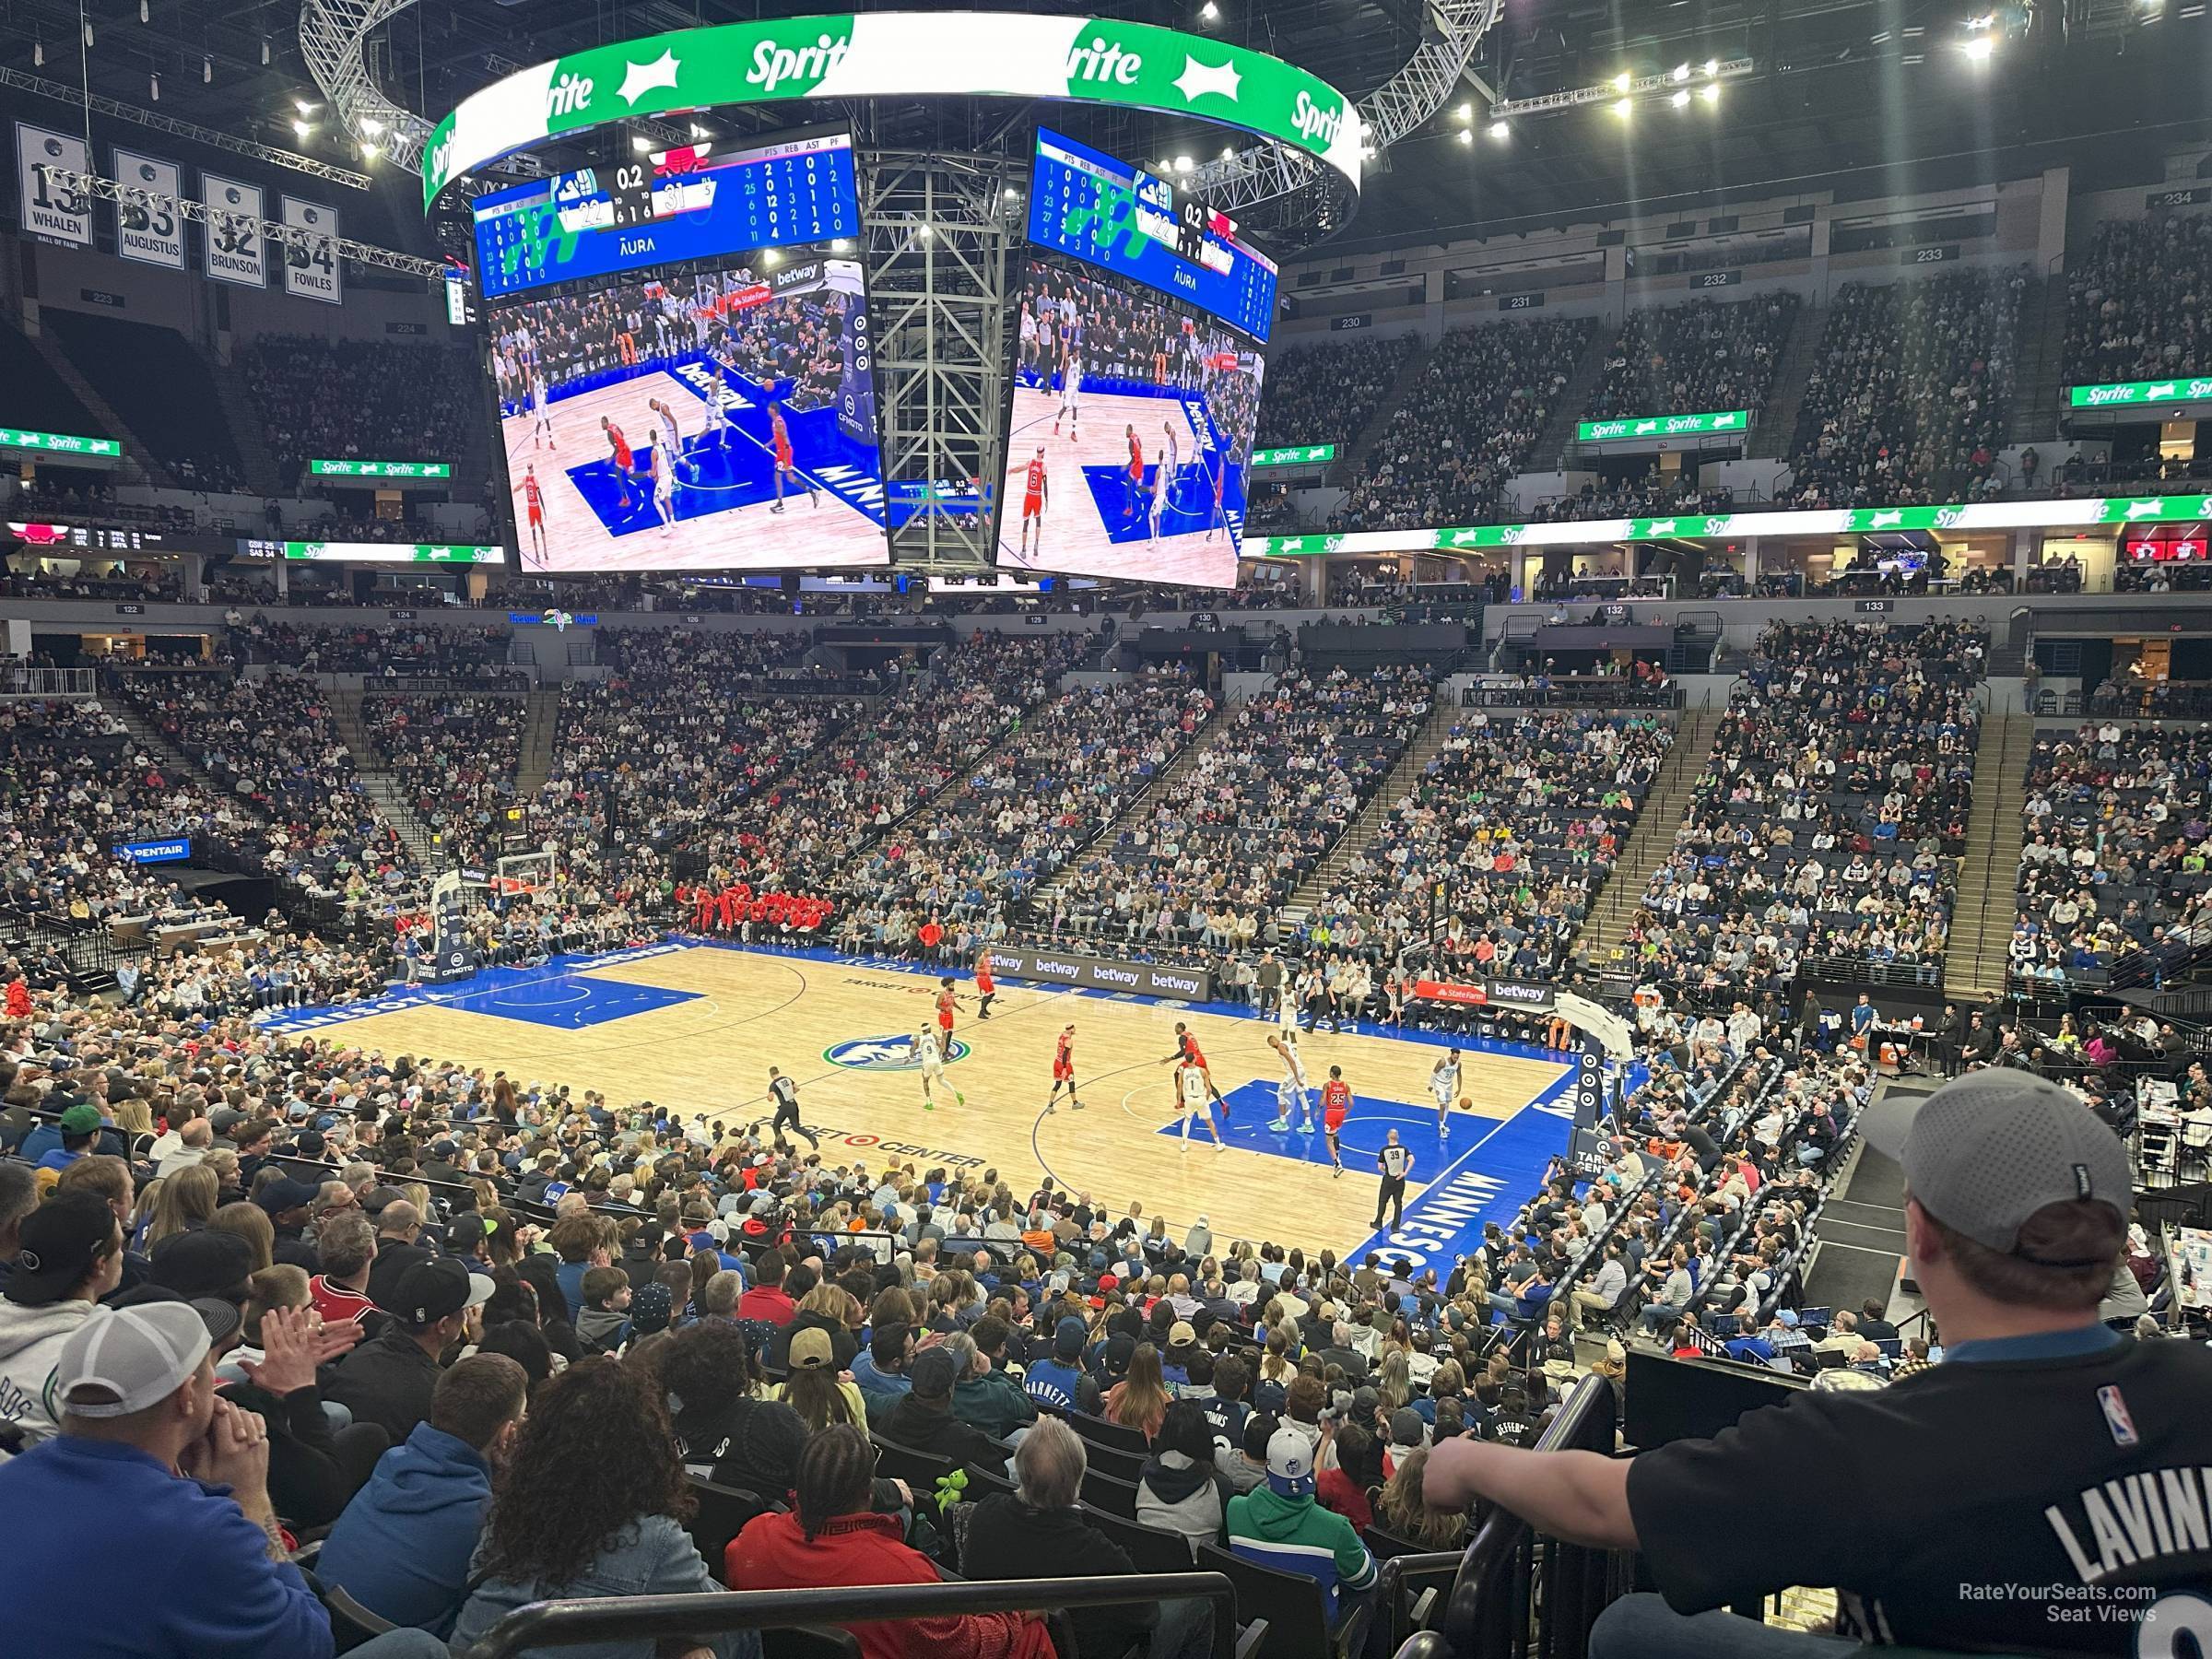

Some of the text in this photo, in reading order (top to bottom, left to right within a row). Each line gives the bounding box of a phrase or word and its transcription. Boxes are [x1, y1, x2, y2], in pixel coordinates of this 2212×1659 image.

[765, 147, 778, 157] PTS
[785, 144, 798, 153] REB
[806, 141, 820, 149] AST
[746, 154, 833, 178] 3 2 2 0 1
[1065, 154, 1106, 176] PTS REB AST
[617, 164, 643, 190] 0.2
[745, 171, 837, 194] 25 0 1 0 2
[1050, 164, 1115, 200] 1 0 0 0 0
[665, 182, 686, 210] 31
[705, 185, 711, 195] 5
[748, 186, 837, 210] 6 12 3 1 1
[1048, 180, 1114, 216] 9 0 0 0 0
[2164, 192, 2192, 205] 234
[579, 199, 603, 227] 22
[1044, 195, 1068, 214] 23 4
[33, 211, 81, 234] WHALEN
[618, 206, 651, 223] 6 1 6
[750, 203, 840, 226] 0 0 2 1 0
[1185, 203, 1203, 229] 0.2
[751, 219, 841, 241] 11 4 1 2 0
[1152, 212, 1171, 242] 22
[38, 235, 53, 244] HALL
[63, 240, 79, 250] FAME
[124, 233, 179, 256] AUGUSTUS
[1178, 240, 1200, 260] 6 1 6
[211, 253, 260, 276] BRUNSON
[1917, 249, 1943, 263] 233
[295, 272, 332, 290] FOWLES
[777, 264, 818, 286] betway
[1704, 273, 1727, 286] 232
[93, 291, 112, 304] 223
[1511, 297, 1531, 308] 231
[1342, 317, 1360, 328] 230
[2086, 385, 2135, 405] Sprite
[839, 413, 863, 432] CFMOTO
[1590, 422, 1627, 438] Sprite
[1665, 417, 1702, 432] Sprite
[48, 436, 81, 450] Sprite
[1272, 450, 1300, 462] Sprite
[321, 462, 352, 474] Sprite
[384, 464, 415, 476] Sprite
[248, 540, 275, 550] GSW 25
[249, 548, 275, 559] SAS 34
[1865, 601, 1884, 611] 133
[1198, 614, 1211, 622] 130
[135, 845, 182, 857] PENTAIR
[462, 868, 486, 880] betway
[564, 943, 687, 970] betway
[988, 954, 1023, 970] etway
[442, 965, 474, 976] CFMOTO
[1035, 959, 1080, 979] betway
[1093, 966, 1139, 986] betway
[842, 978, 1006, 1005] TARGET CNTR
[1151, 973, 1199, 994] betway
[1495, 983, 1546, 1002] betway
[925, 1045, 933, 1054] 9
[1888, 1052, 1898, 1062] G
[1190, 1080, 1195, 1091] 1
[1330, 1093, 1345, 1105] 25
[877, 1141, 987, 1169] CENTER
[1390, 1150, 1399, 1159] 39
[1025, 1382, 1071, 1406] GARNETT
